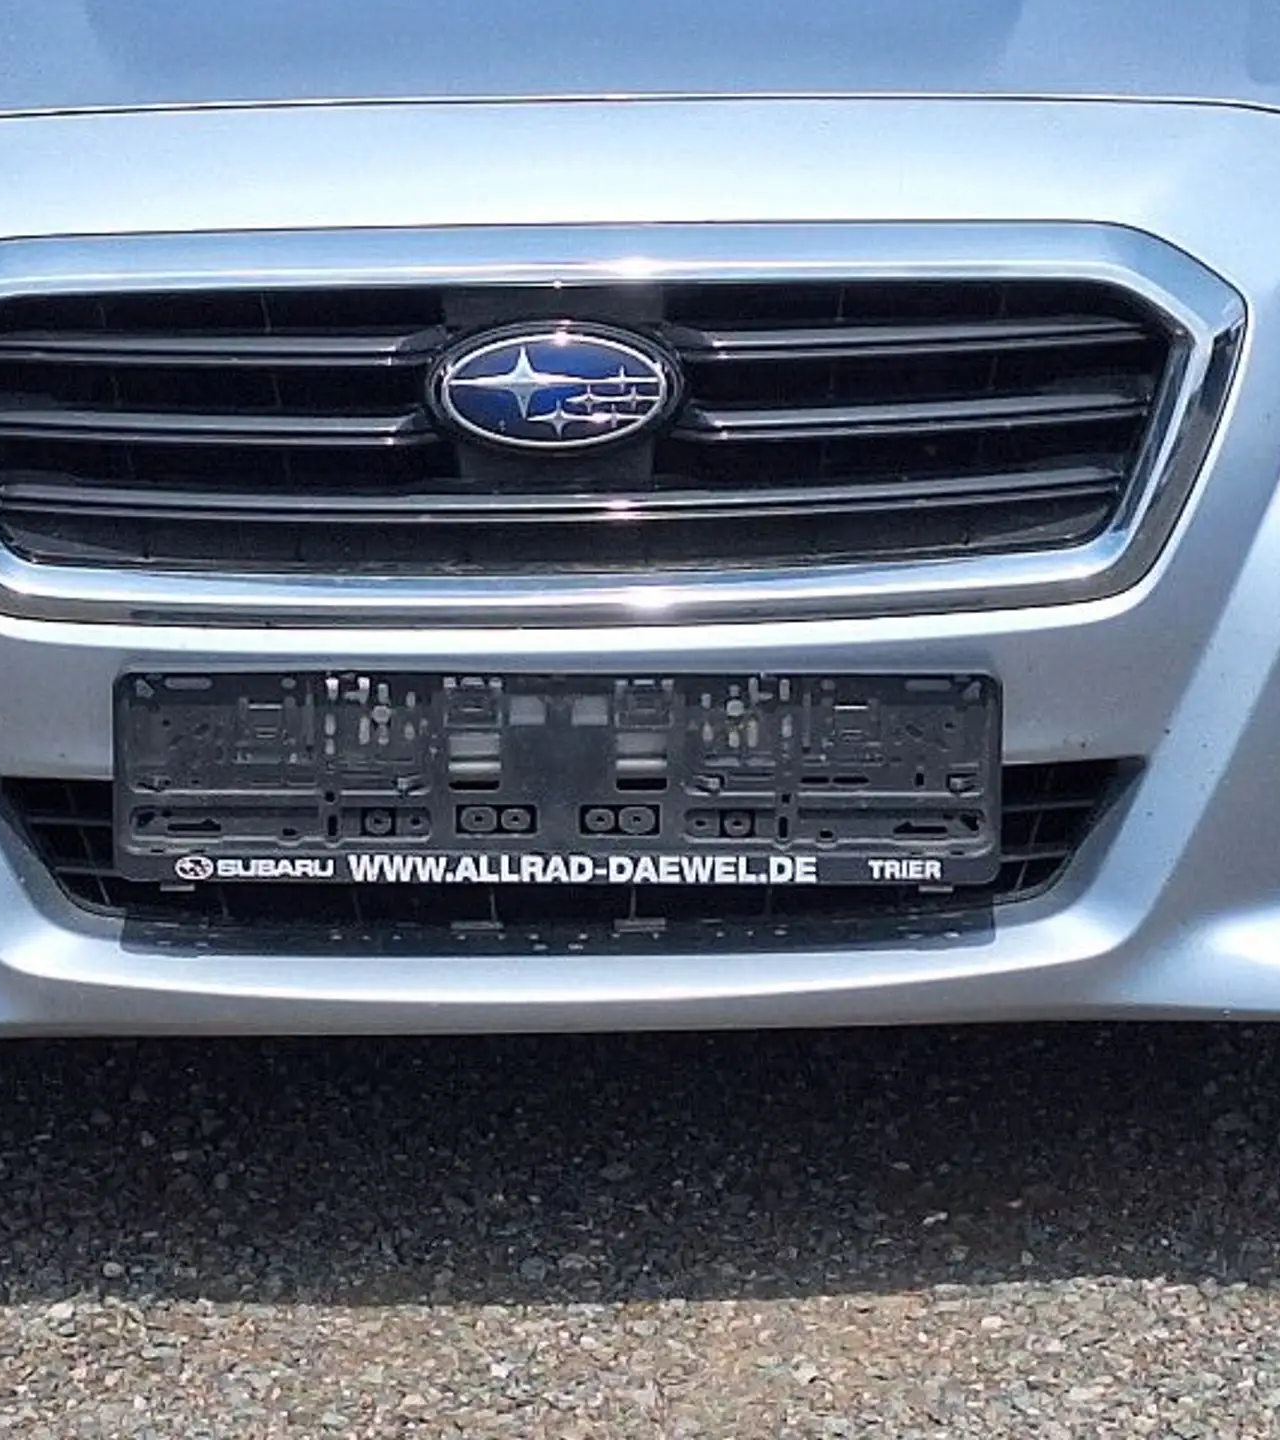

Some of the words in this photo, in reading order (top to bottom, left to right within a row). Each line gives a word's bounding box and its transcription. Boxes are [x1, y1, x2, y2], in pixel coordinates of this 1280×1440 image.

[217, 859, 334, 877] SUBARU
[348, 854, 818, 884] WWW.ALLRAD-DAEWEL.DE
[868, 859, 942, 880] TRIER
